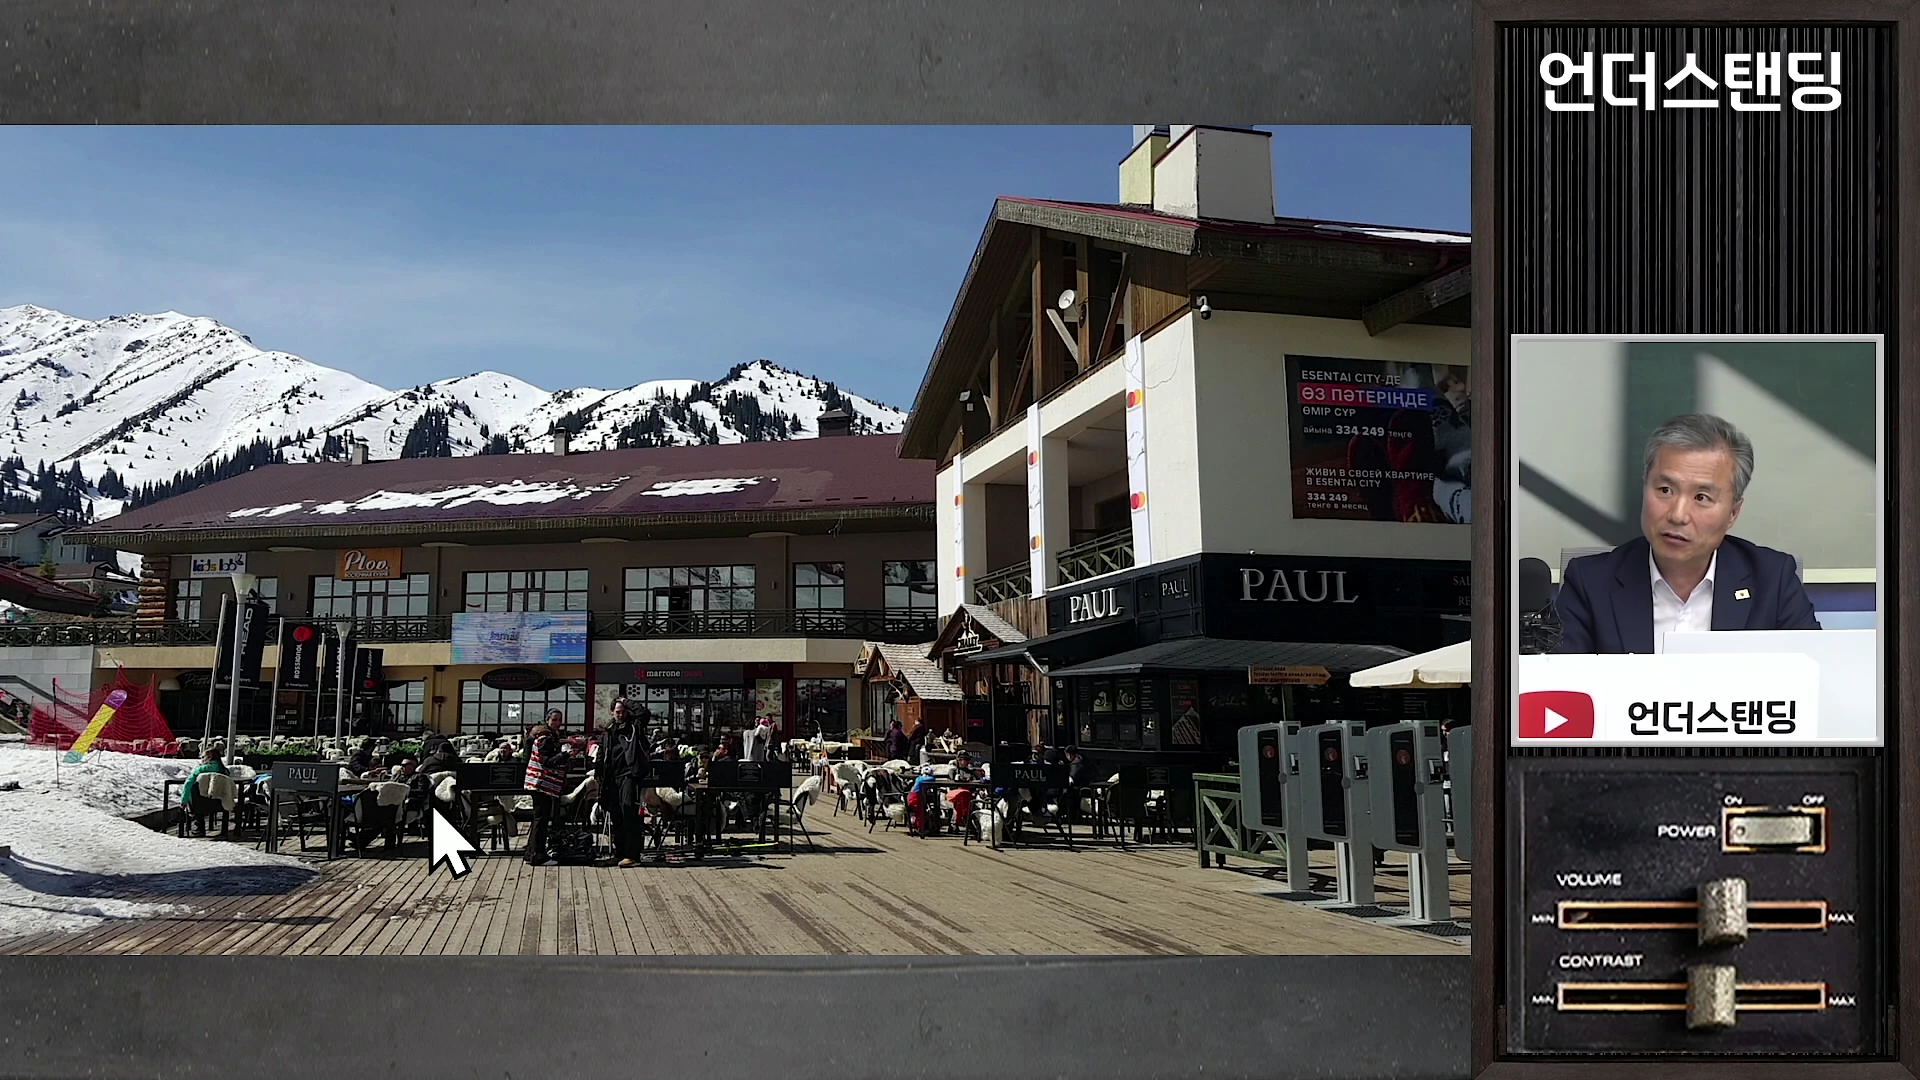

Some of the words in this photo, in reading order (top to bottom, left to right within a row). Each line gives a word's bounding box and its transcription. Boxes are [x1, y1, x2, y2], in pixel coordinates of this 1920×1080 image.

[1301, 370, 1351, 382] ESENTAI
[1354, 373, 1401, 387] CITY-ДЕ
[1301, 387, 1327, 401] ӨЗ
[1331, 389, 1428, 409] ПӘТЕРІҢДЕ
[1302, 406, 1331, 417] ӨМІР
[1303, 426, 1332, 435] айына
[1335, 424, 1358, 436] 334
[1362, 425, 1385, 437] 249
[1388, 430, 1413, 440] теңге
[1305, 467, 1337, 477] ЖИВИ
[1339, 468, 1346, 477] В
[1348, 468, 1383, 479] СВОЕЙ
[1385, 471, 1435, 481] КВАРТИРЕ
[1306, 478, 1313, 487] В
[1315, 478, 1357, 487] ESENTAI
[1359, 479, 1381, 488] CITY
[1306, 492, 1326, 501] 334
[1328, 493, 1348, 502] 249
[1307, 502, 1331, 511] тенге
[1341, 503, 1368, 512] месяц
[1161, 578, 1188, 596] PAUL
[1239, 568, 1359, 603] PAUL
[1070, 587, 1126, 623] PAUL
[646, 670, 681, 678] marrone
[288, 767, 319, 780] PAUL
[1015, 769, 1046, 780] PAUL
